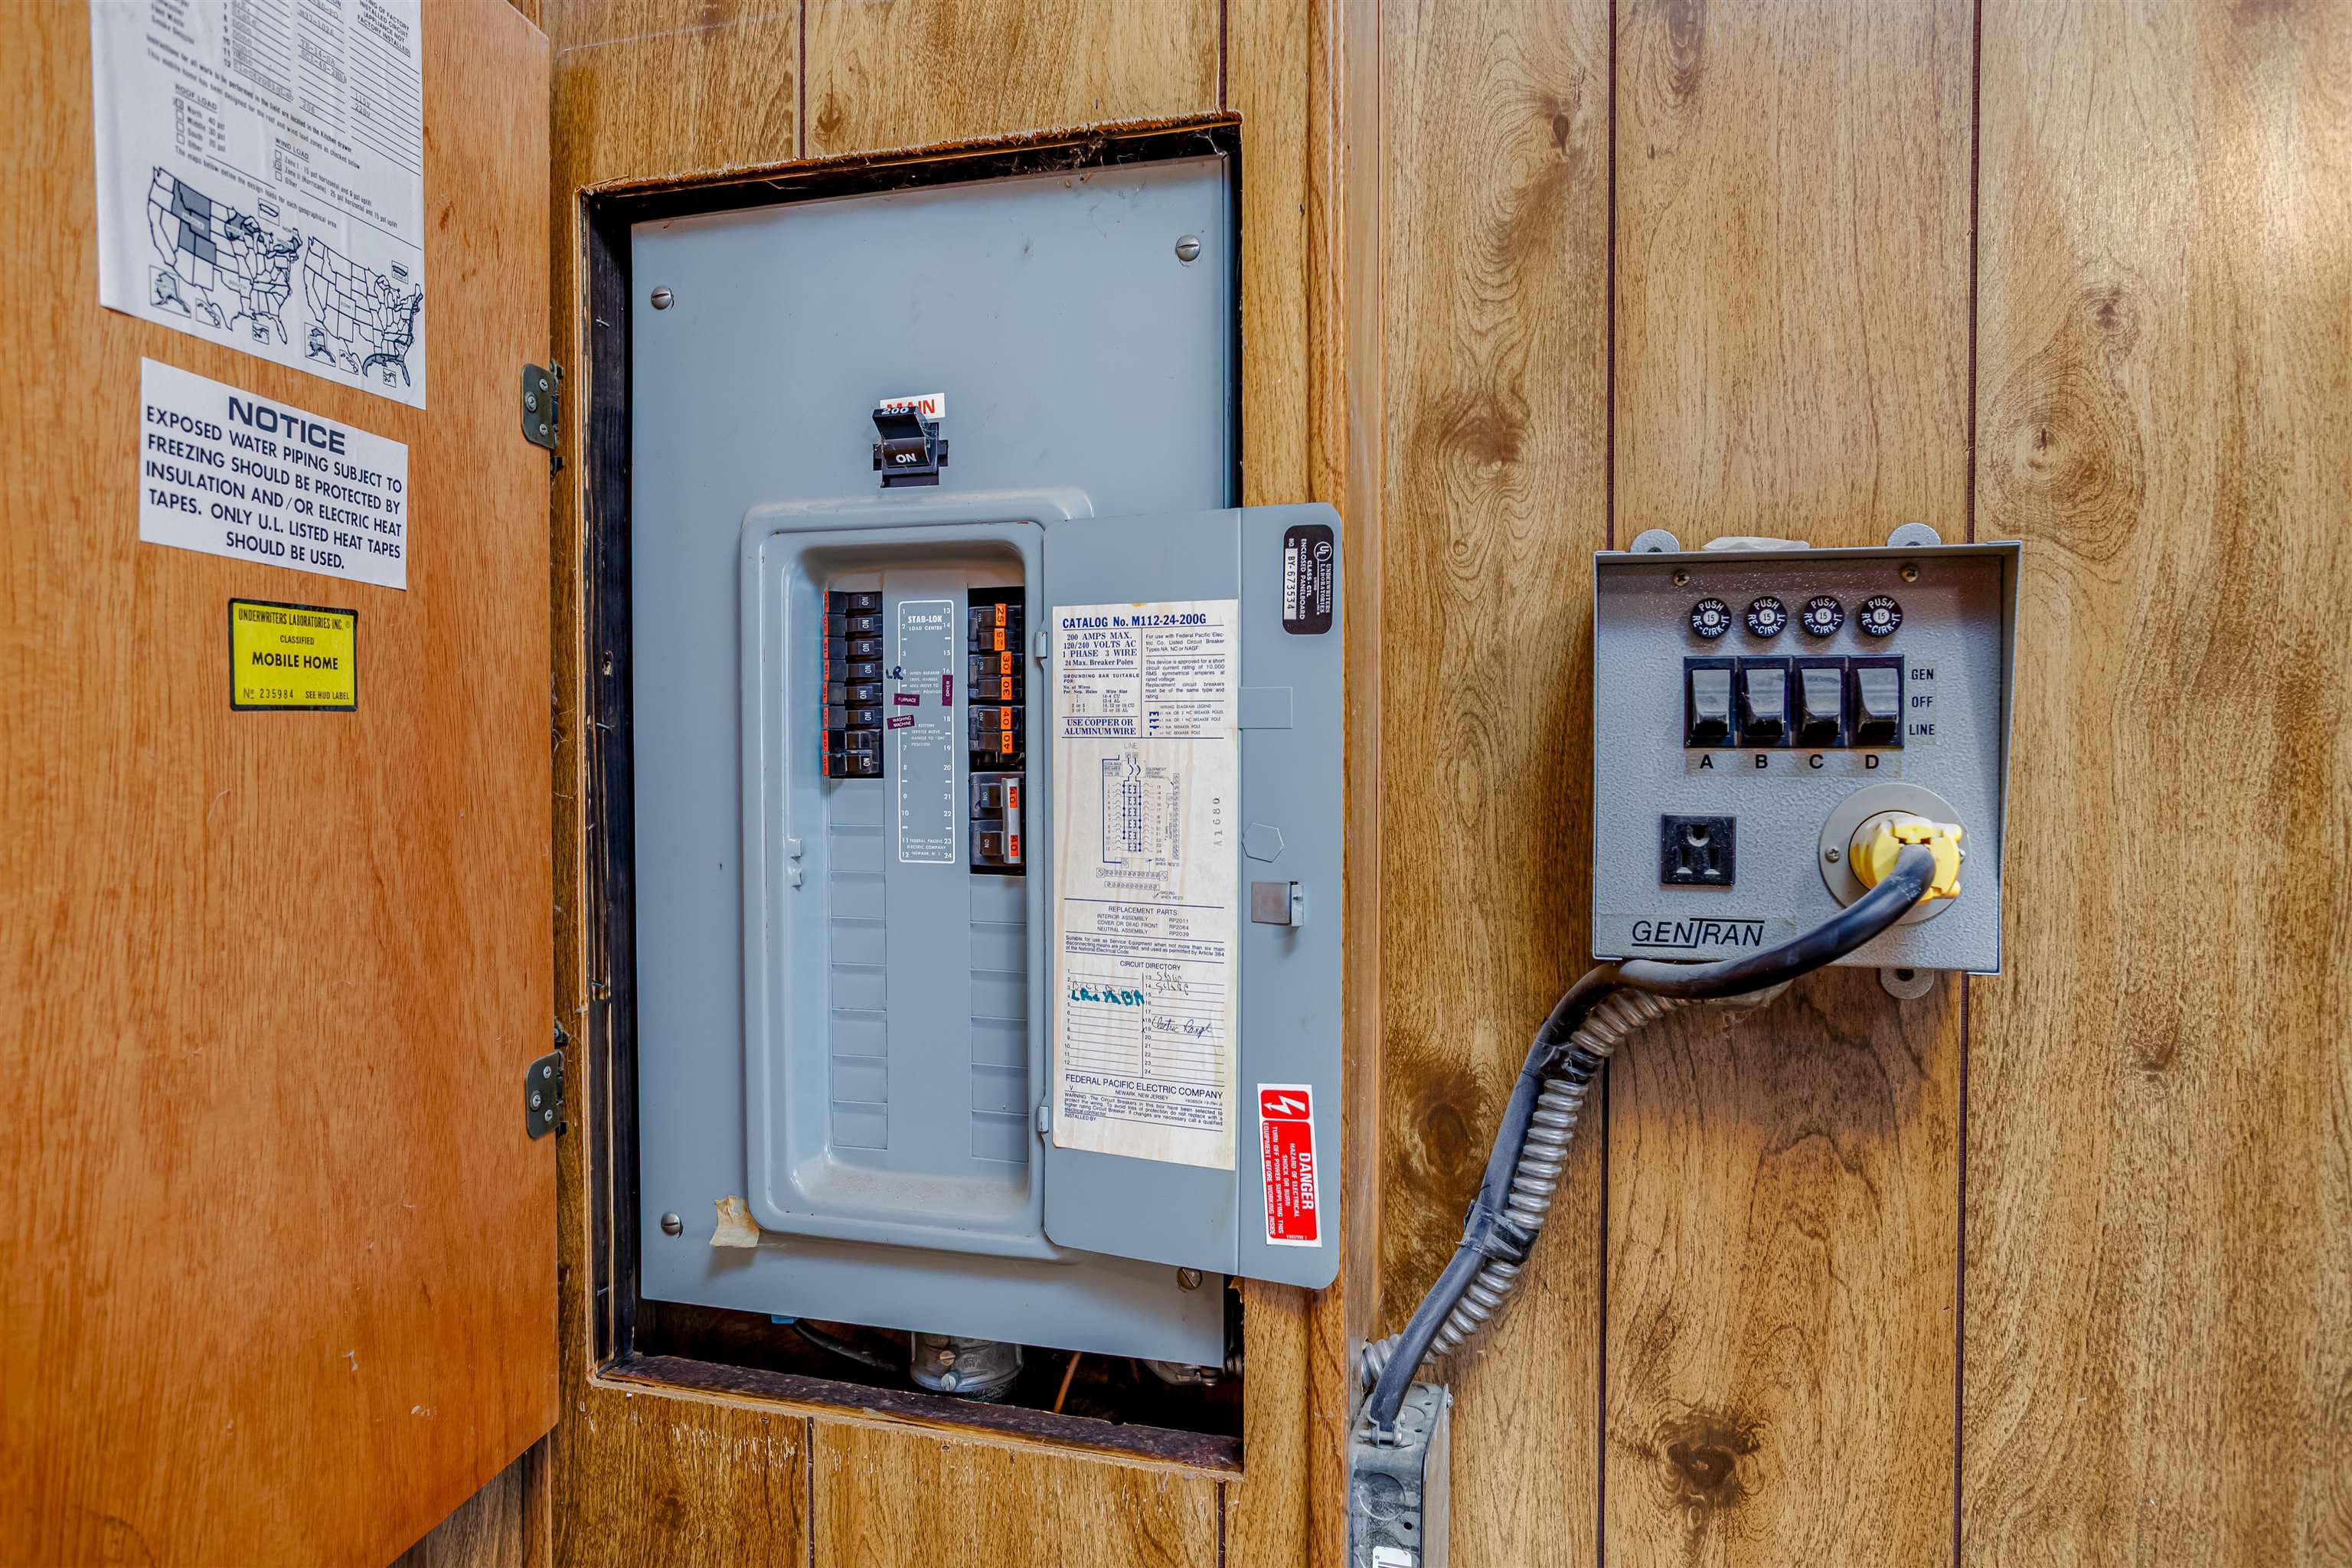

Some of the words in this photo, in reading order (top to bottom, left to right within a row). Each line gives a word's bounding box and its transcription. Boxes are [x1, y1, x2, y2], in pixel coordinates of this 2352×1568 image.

[357, 14, 381, 34] FACTORY
[387, 12, 410, 31] FACTORY
[388, 21, 409, 39] CIRCUIT
[394, 32, 404, 43] NOT
[293, 147, 310, 160] LOAD
[228, 396, 345, 456] NOTICE
[147, 406, 222, 441] EXPOSED
[229, 430, 277, 458] WATER
[283, 446, 328, 472] PIPING
[334, 458, 381, 487] SUBJECT
[387, 478, 402, 493] TO
[896, 454, 916, 463] ON
[148, 433, 225, 468] FREEZING
[232, 456, 289, 485] SHOULD
[296, 475, 310, 492] BE
[315, 482, 381, 511] PROTECTED
[387, 499, 400, 515] BY
[146, 461, 245, 500] INSULATION
[319, 505, 369, 529] ELECTRIC
[374, 519, 401, 537] HEAT
[149, 488, 201, 516] TAPES.
[211, 503, 252, 528] ONLY
[259, 514, 284, 533] U.L.
[289, 521, 328, 542] LISTED
[334, 529, 362, 548] HEAT
[367, 538, 400, 559] TAPES
[226, 532, 285, 557] SHOULD
[290, 545, 305, 561] BE
[310, 548, 345, 570] USED.
[1287, 557, 1295, 609] BY-673534
[862, 596, 869, 606] ON
[1698, 600, 1724, 612] PUSH
[1753, 599, 1779, 610] PUSH
[1810, 598, 1836, 609] PUSH
[1868, 598, 1895, 609] PUSH
[238, 609, 287, 626] UNDERWRITERS
[289, 613, 331, 629] LABORATORIES
[332, 620, 343, 630] INC.
[997, 608, 1004, 622] 25
[1063, 617, 1108, 628] CATALOG
[1113, 616, 1129, 626] No.
[1132, 613, 1206, 626] M112-24-200G
[862, 619, 869, 628] ON
[1693, 615, 1730, 636] RE-CIRK-IT
[1748, 614, 1787, 635] RE-CIRK-IT
[1804, 612, 1843, 634] RE-CIRK-IT
[1862, 612, 1901, 634] RE-CIRK-IT
[280, 635, 315, 645] CLASSIFIED
[863, 644, 869, 652] ON
[252, 652, 299, 668] MOBILE
[303, 655, 338, 670] HOME
[1003, 656, 1010, 670] 30
[865, 665, 871, 674] ON
[1912, 669, 1934, 680] GEN
[260, 689, 293, 698] 235984
[860, 691, 867, 699] ON
[1003, 681, 1010, 695] 30
[318, 691, 330, 700] HUD
[332, 691, 349, 700] LABEL
[1912, 697, 1932, 707] OFF
[865, 712, 871, 720] ON
[1003, 711, 1009, 725] 40
[1909, 724, 1935, 735] LINE
[1004, 735, 1010, 749] 40
[864, 758, 870, 766] ON
[1700, 755, 1713, 769] A
[1756, 755, 1768, 769] B
[1809, 754, 1824, 769] C
[1866, 755, 1879, 769] D
[1010, 788, 1016, 803] 40
[1011, 837, 1017, 851] 40
[1157, 907, 1177, 916] PARTS
[1632, 918, 1765, 949] GENTRAN
[1119, 960, 1144, 969] CIRCUIT
[1145, 962, 1181, 971] DIRECTORY
[1152, 1016, 1178, 1033] Electric
[1066, 1074, 1101, 1086] FEDERAL
[1103, 1079, 1134, 1089] PACIFIC
[1137, 1083, 1176, 1094] ELECTRIC
[1179, 1087, 1223, 1099] COMPANY
[1283, 1178, 1289, 1186] OR
[1298, 1152, 1314, 1210] DANGER
